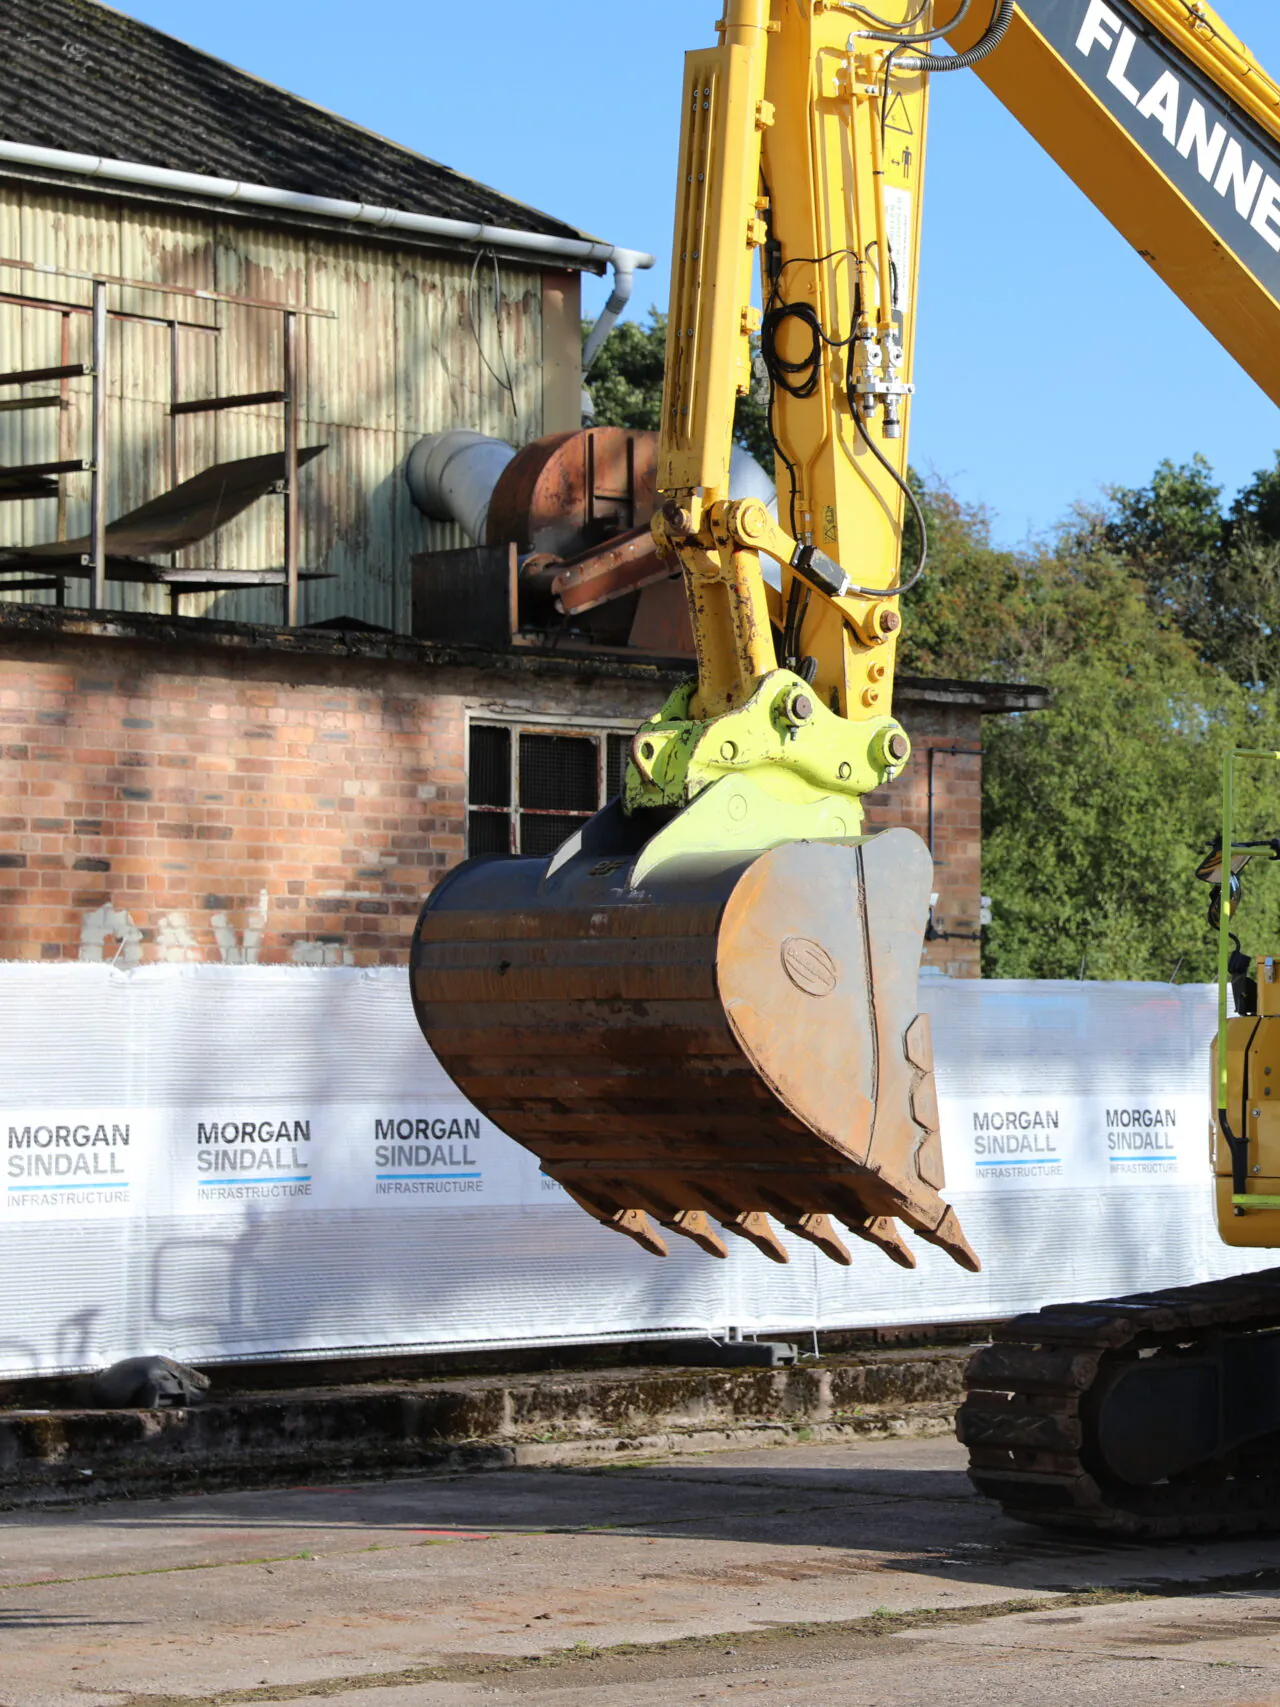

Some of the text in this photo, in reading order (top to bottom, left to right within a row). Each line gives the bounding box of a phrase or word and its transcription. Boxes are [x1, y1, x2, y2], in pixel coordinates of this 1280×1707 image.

[375, 1118, 480, 1140] MORGAN
[973, 1110, 1059, 1131] MORGAN
[1106, 1109, 1176, 1128] MORGAN
[8, 1124, 130, 1149] MORGAN
[197, 1120, 311, 1144] MORGAN
[1107, 1131, 1174, 1151] SINDALL
[974, 1134, 1056, 1155] SINDALL
[7, 1152, 125, 1178] SINDALL
[197, 1147, 309, 1172] SINDALL
[375, 1144, 477, 1167] SINDALL
[975, 1165, 1064, 1179] INFRASTRUCTURE
[197, 1184, 312, 1200] INFRASTRUCTURE
[375, 1180, 484, 1194] INFRASTRUCTURE
[7, 1191, 131, 1207] INFRASTRUCTURE
